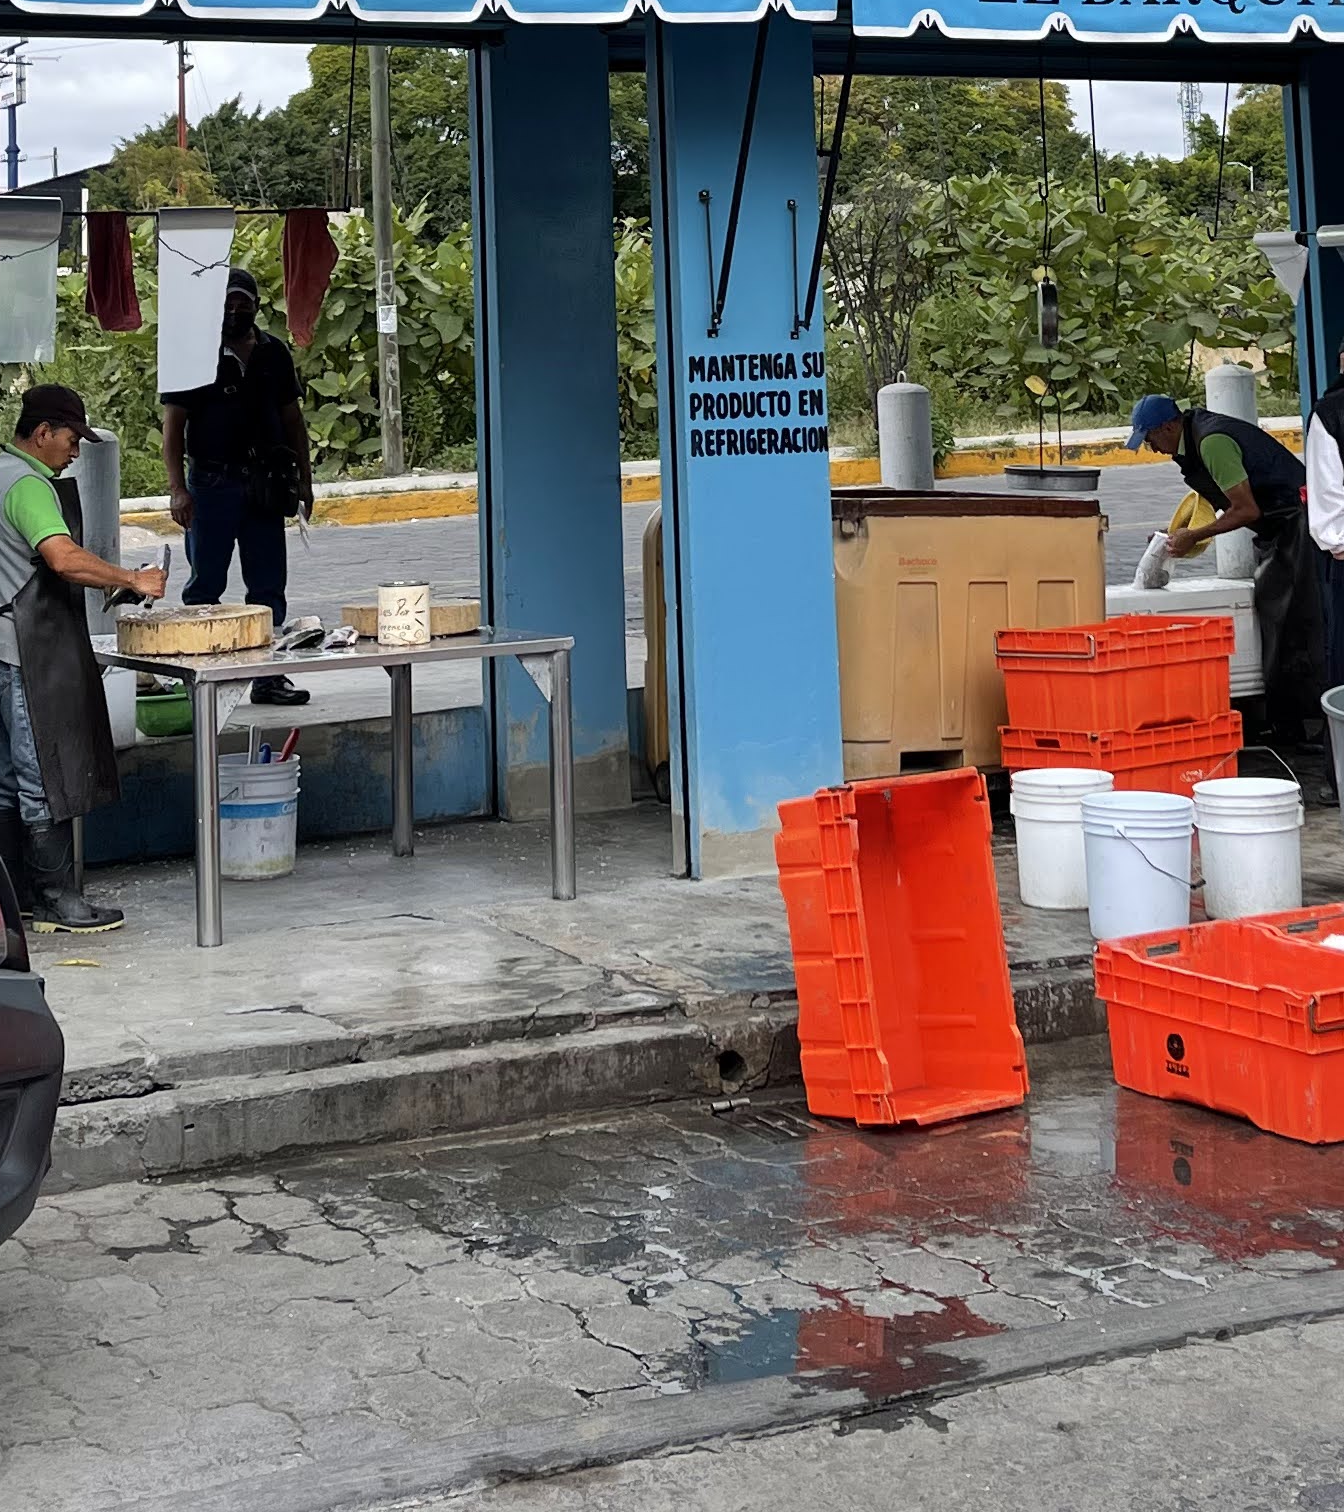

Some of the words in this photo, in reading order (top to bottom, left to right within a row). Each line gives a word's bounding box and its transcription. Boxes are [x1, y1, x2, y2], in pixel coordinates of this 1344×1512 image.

[688, 352, 798, 383] MANTENGA
[801, 351, 825, 379] SU
[689, 390, 791, 421] PRODUCTO
[798, 388, 824, 417] EN
[690, 426, 829, 458] REFRIGERACION
